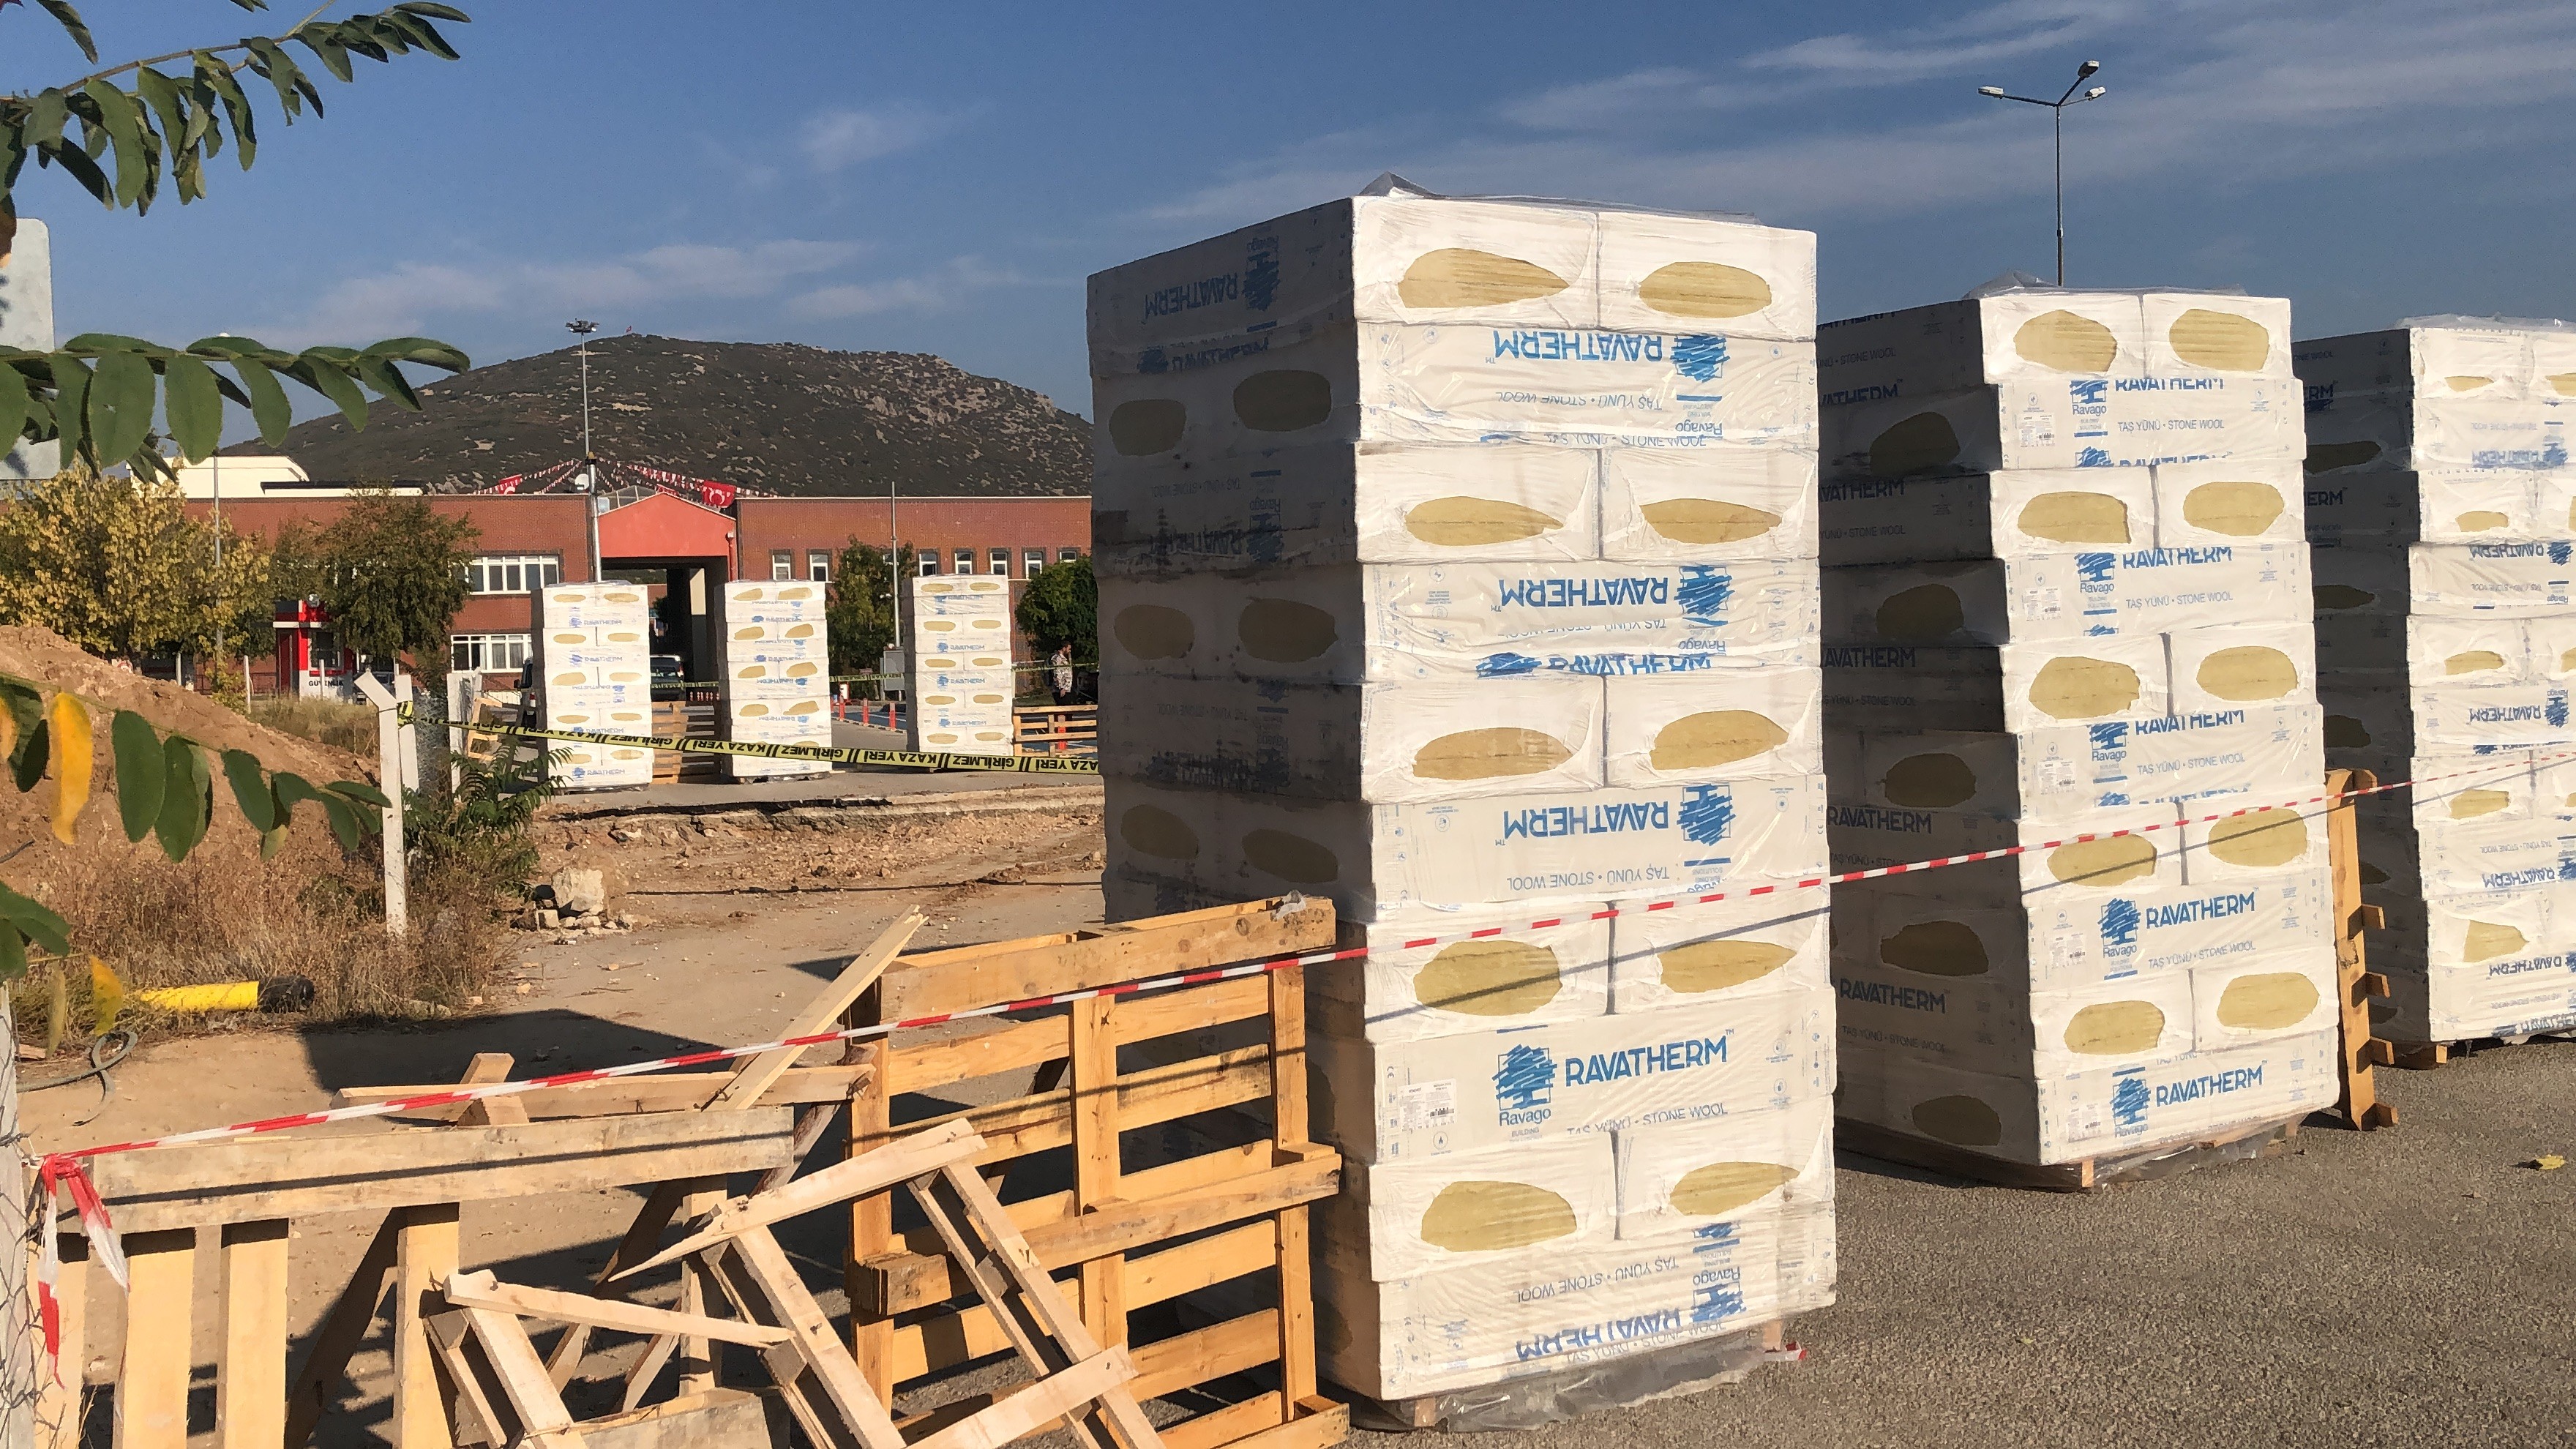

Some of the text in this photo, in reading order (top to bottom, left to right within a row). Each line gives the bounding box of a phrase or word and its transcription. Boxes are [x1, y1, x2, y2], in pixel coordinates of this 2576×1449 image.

[2072, 404, 2107, 416] Ravago
[1675, 421, 1723, 438] Ravago
[2168, 419, 2197, 430] STONE
[2198, 419, 2225, 430] WOOL
[2080, 583, 2115, 594] Ravago
[2177, 594, 2206, 605] STONE
[2207, 592, 2234, 602] WOOL
[1678, 639, 1726, 652] Ravago
[1824, 646, 1916, 668] AVATHERM
[729, 741, 766, 753] KAZA
[781, 745, 844, 758] GİRİLMEZ
[864, 750, 896, 763] YERİ
[899, 752, 937, 764] KAZA
[952, 755, 1015, 770] GİRİLMEZ
[2092, 749, 2127, 762] Ravago
[2187, 757, 2217, 769] STONE
[2219, 753, 2246, 765] WOOL
[1036, 759, 1067, 771] YERİ
[1507, 864, 1670, 891] TAŞ YÜNÜ STONE WOOL
[2103, 945, 2138, 958] Ravago
[2229, 939, 2256, 953] WOOL
[1840, 978, 1947, 1014] RAVATHERM
[1499, 1107, 1551, 1127] Ravago
[1642, 1107, 1685, 1126] STONE
[1689, 1102, 1729, 1118] WOOL
[2113, 1123, 2149, 1139] Ravago
[1654, 1255, 1679, 1272] TAŞ
[1559, 1271, 1603, 1293] STONE
[1693, 1266, 1741, 1286] Ravago
[1516, 1285, 1556, 1303] WOOL
